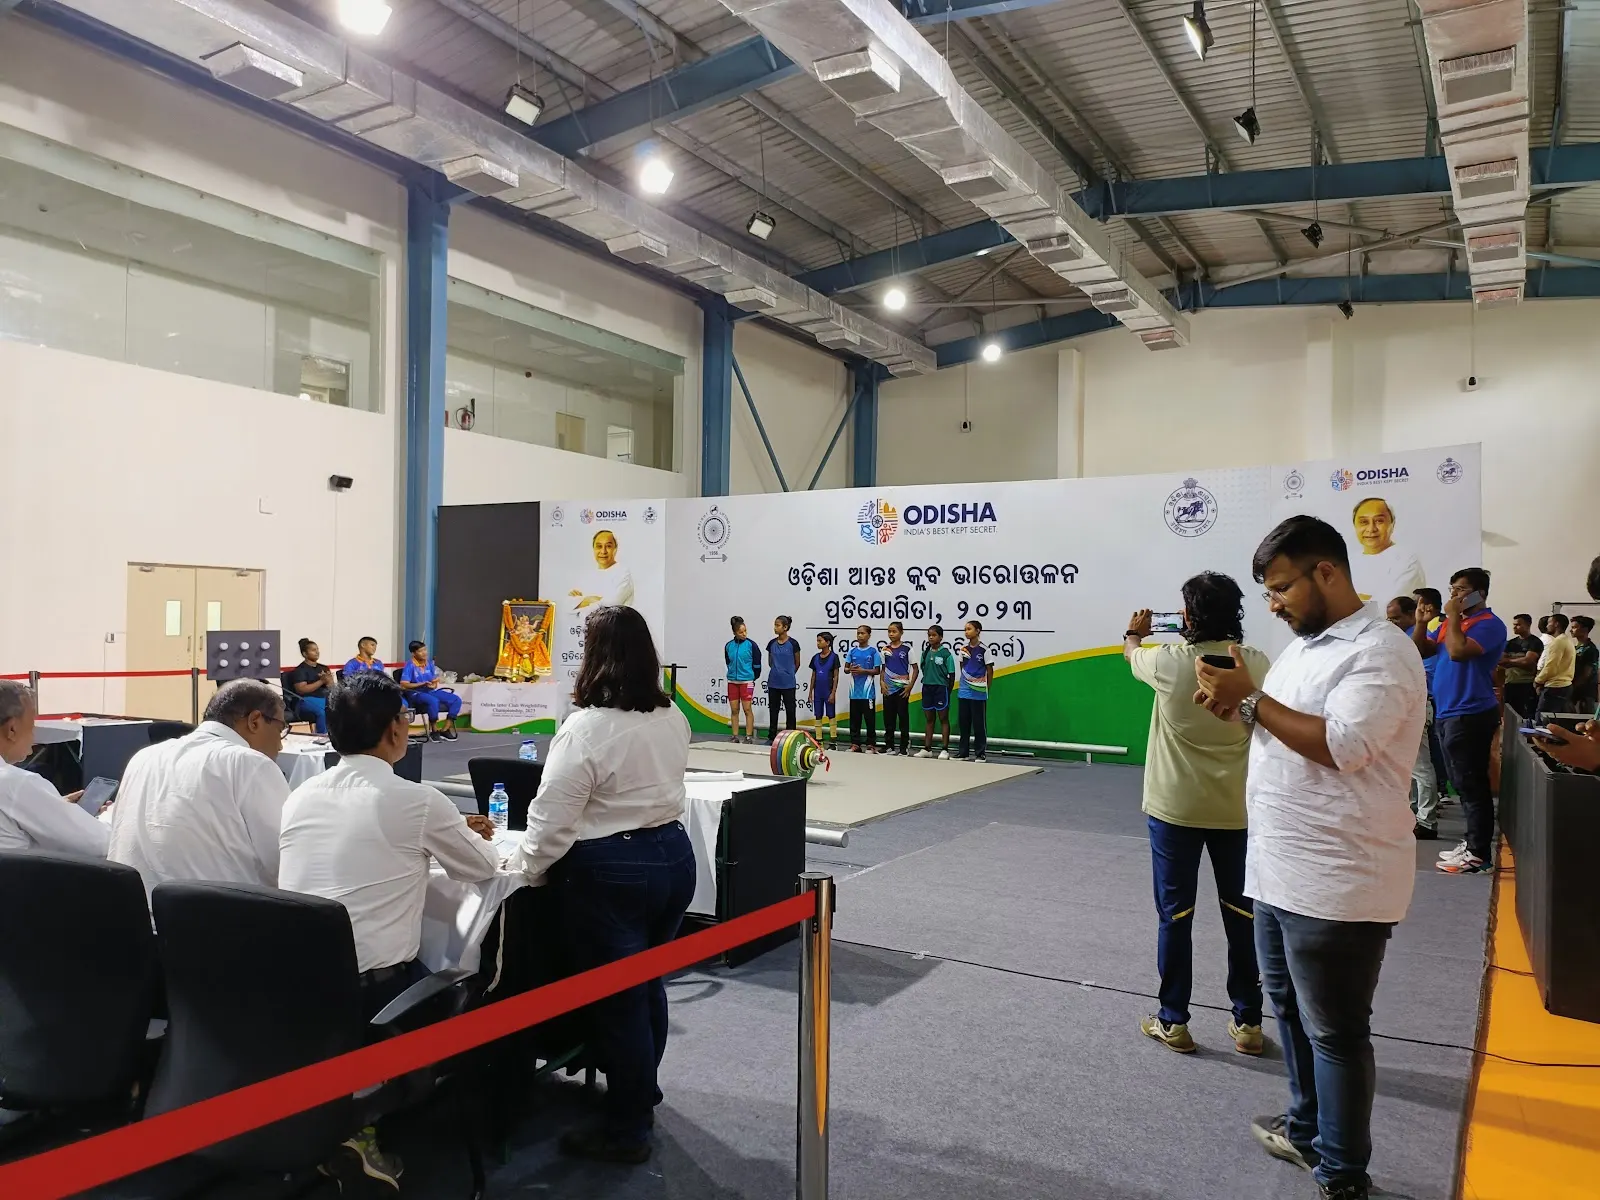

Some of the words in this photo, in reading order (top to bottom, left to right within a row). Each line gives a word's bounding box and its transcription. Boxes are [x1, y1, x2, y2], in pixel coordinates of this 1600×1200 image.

[1356, 467, 1409, 481] ODISHA
[595, 510, 627, 518] ODISHA
[903, 502, 997, 525] ODISHA
[903, 528, 931, 536] INDIA'S
[932, 527, 949, 535] BEST
[951, 526, 968, 534] KEPT
[788, 562, 838, 592] ଓଡ଼ିଶା
[848, 566, 896, 586] ଆନ୍ତଃ
[906, 565, 941, 591] କ୍ଲବ
[957, 600, 1032, 621] ୨୦୨୩
